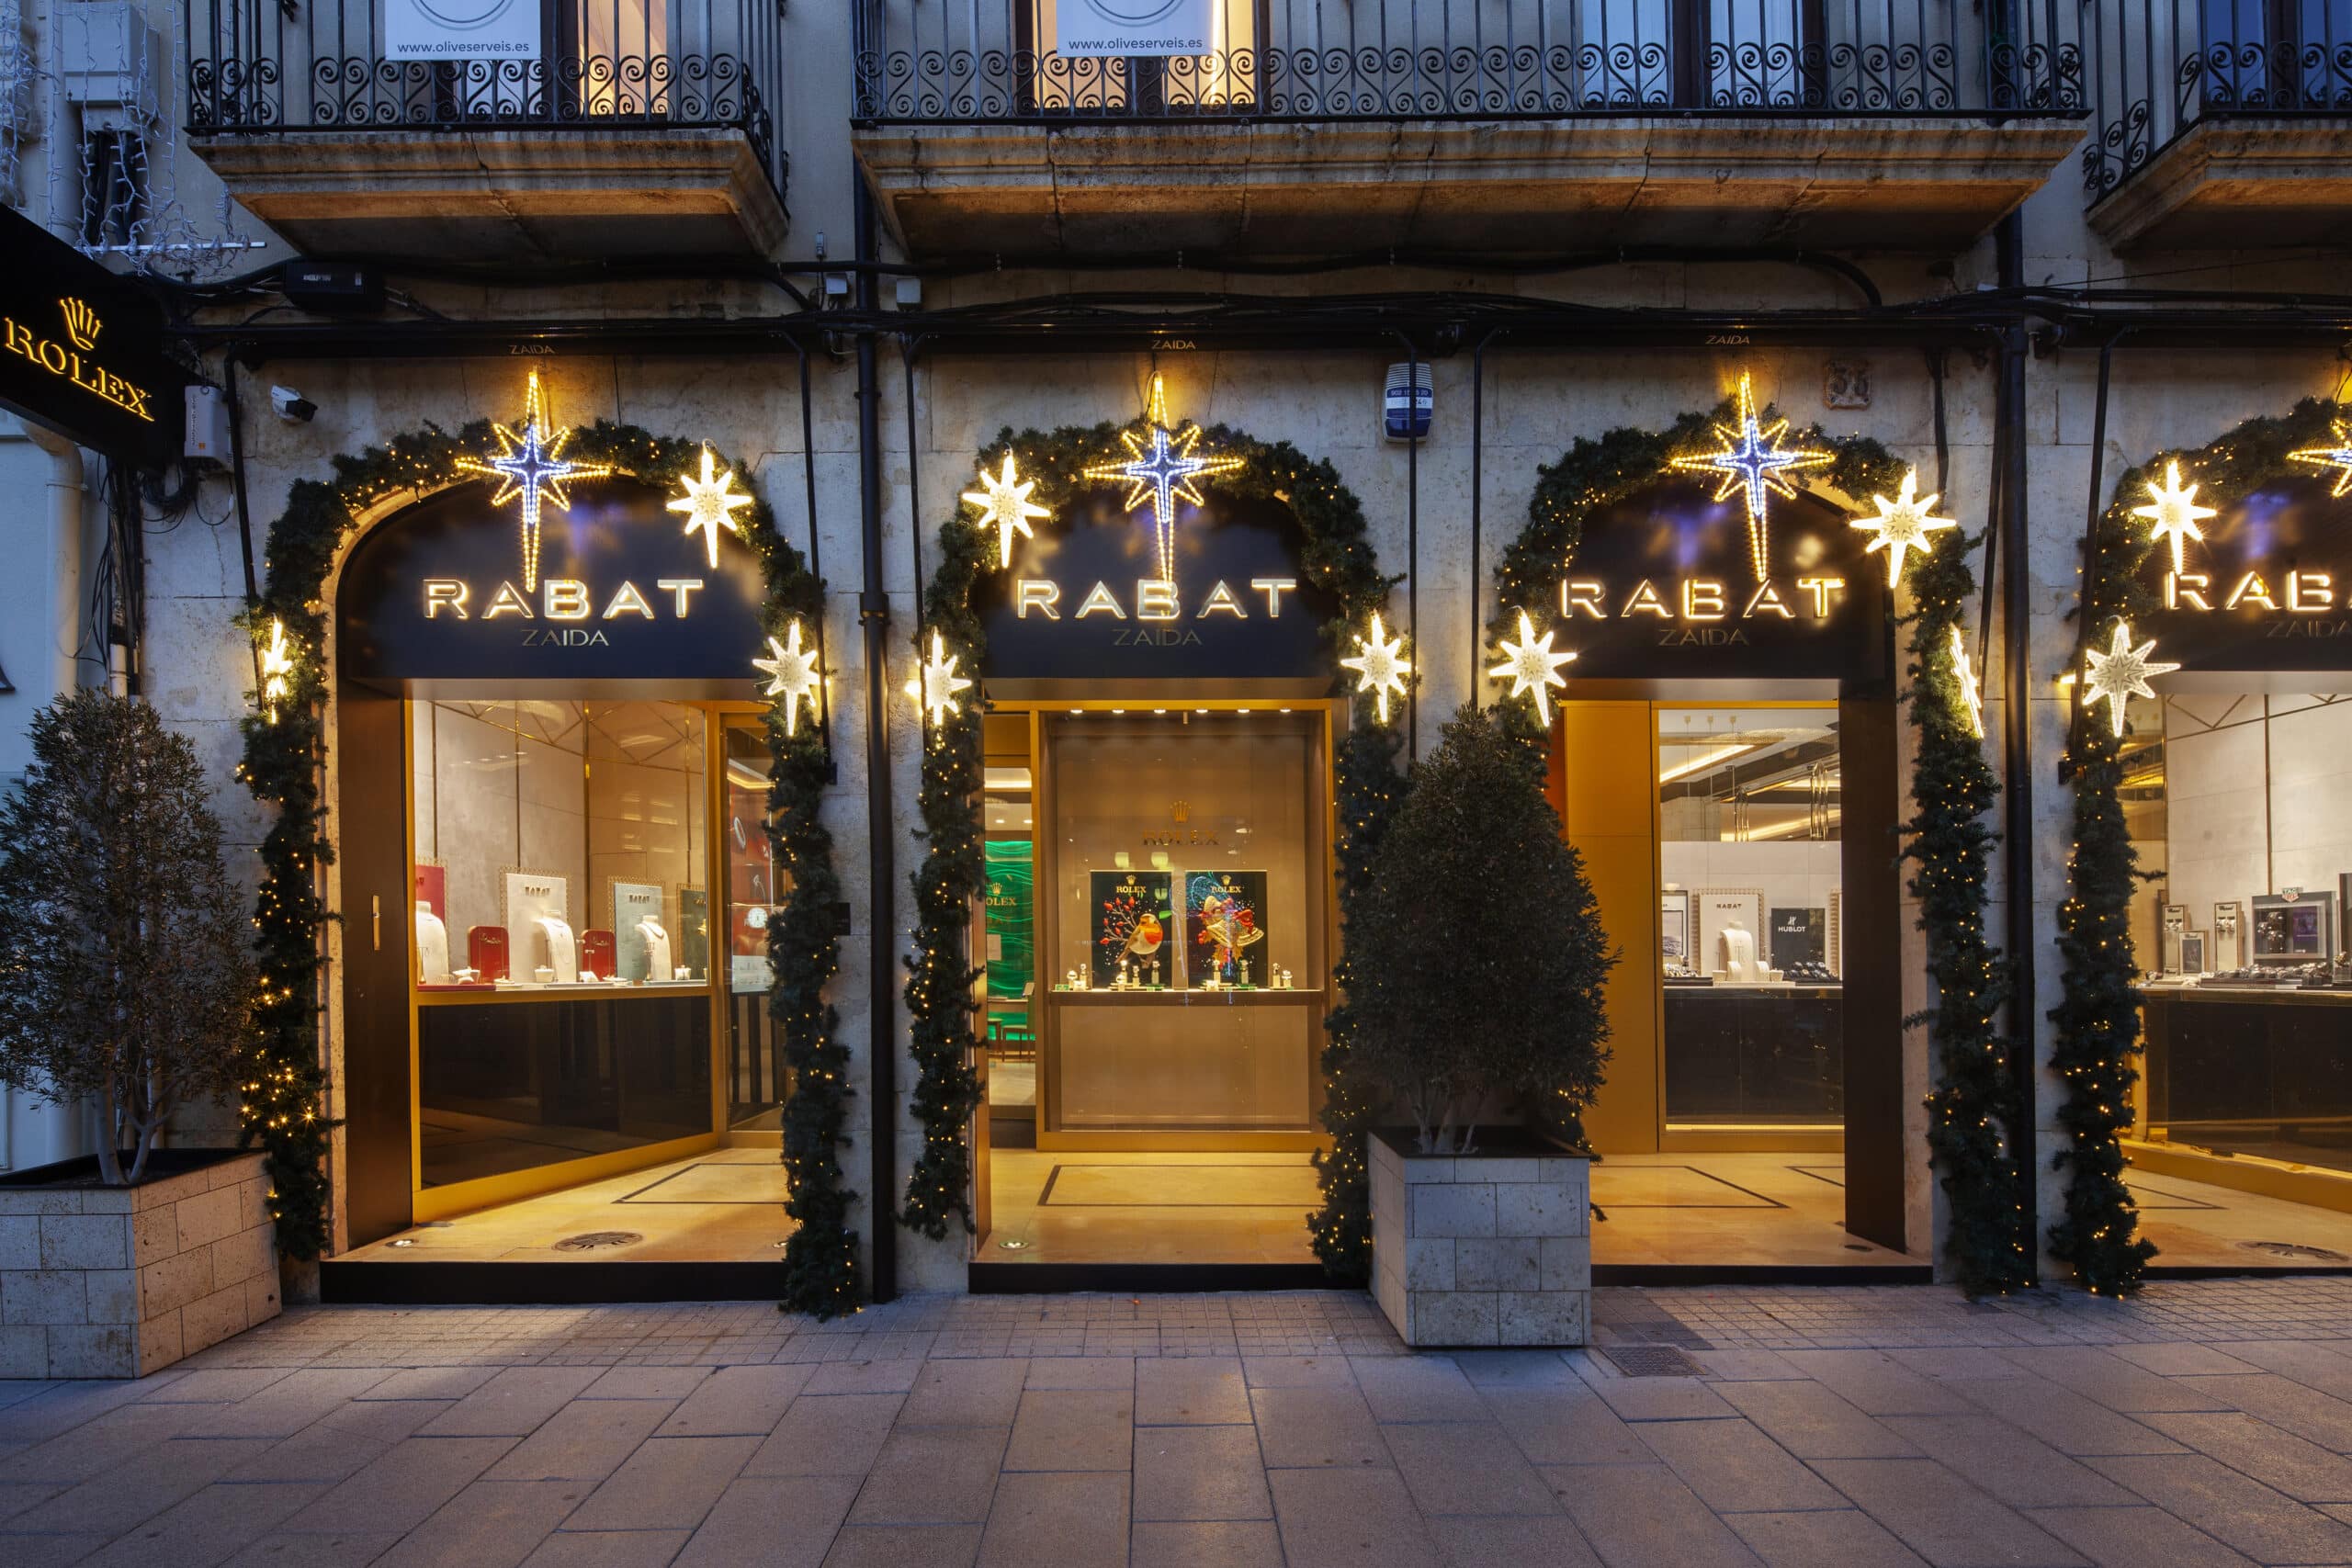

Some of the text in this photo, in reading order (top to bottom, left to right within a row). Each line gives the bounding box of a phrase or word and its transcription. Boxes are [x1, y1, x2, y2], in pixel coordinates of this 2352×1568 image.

[397, 40, 530, 53] www.oliveserveis.es
[1069, 37, 1203, 50] www.oliveserveis.es
[1152, 339, 1196, 350] ZAIDA
[1704, 334, 1750, 344] ZAIDA
[509, 344, 556, 355] ZAIDA
[4, 317, 155, 423] ROLEX
[422, 578, 703, 620] RABAT
[1017, 578, 1297, 620] RABAT
[1561, 577, 1845, 619] RABAT
[2164, 570, 2352, 612] RAB
[520, 629, 610, 647] ZAIDA
[1112, 628, 1203, 646] ZAIDA
[1657, 628, 1749, 646] ZAIDA
[1142, 829, 1220, 846] ROLEX
[1115, 886, 1148, 894] ROLEX
[1210, 886, 1242, 894] ROLEX
[986, 897, 1017, 907] OLEX
